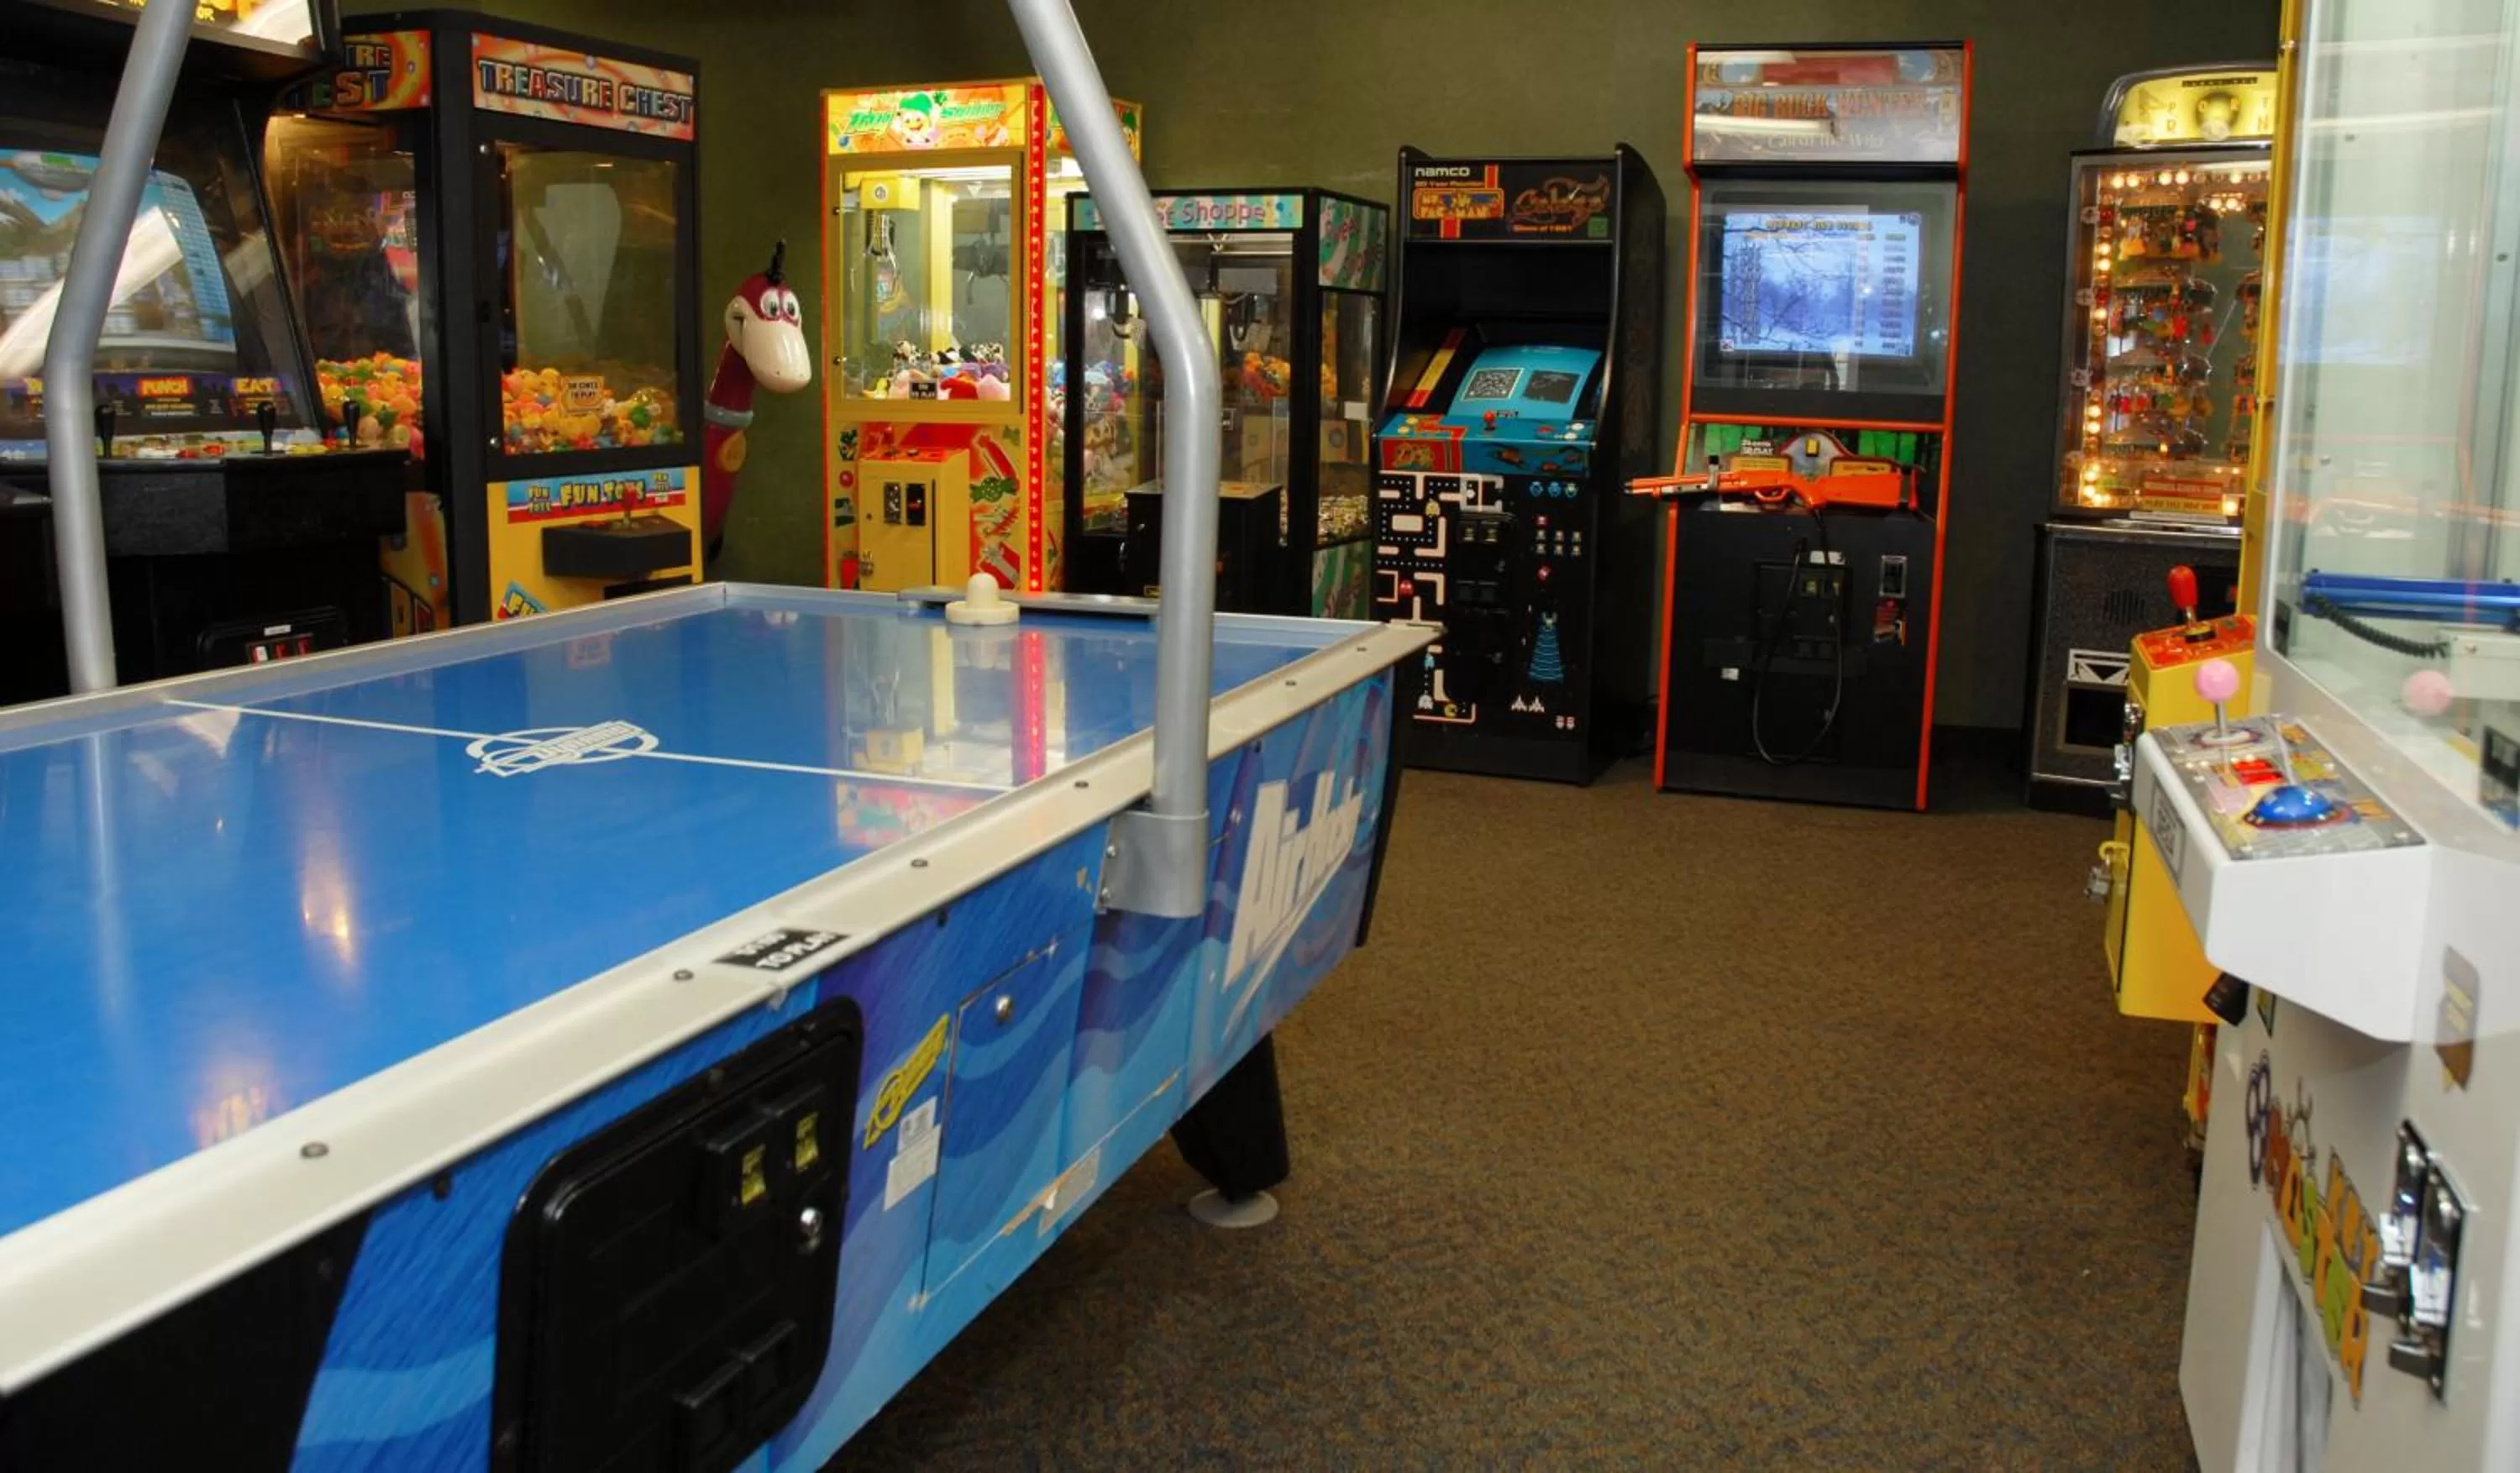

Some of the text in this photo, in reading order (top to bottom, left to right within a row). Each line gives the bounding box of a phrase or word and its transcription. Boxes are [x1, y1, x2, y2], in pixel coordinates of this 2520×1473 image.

[479, 59, 694, 124] TREASURE CHEST
[1415, 167, 1470, 177] namco
[1182, 199, 1266, 226] Shoppe
[560, 480, 645, 508] FUN TOS
